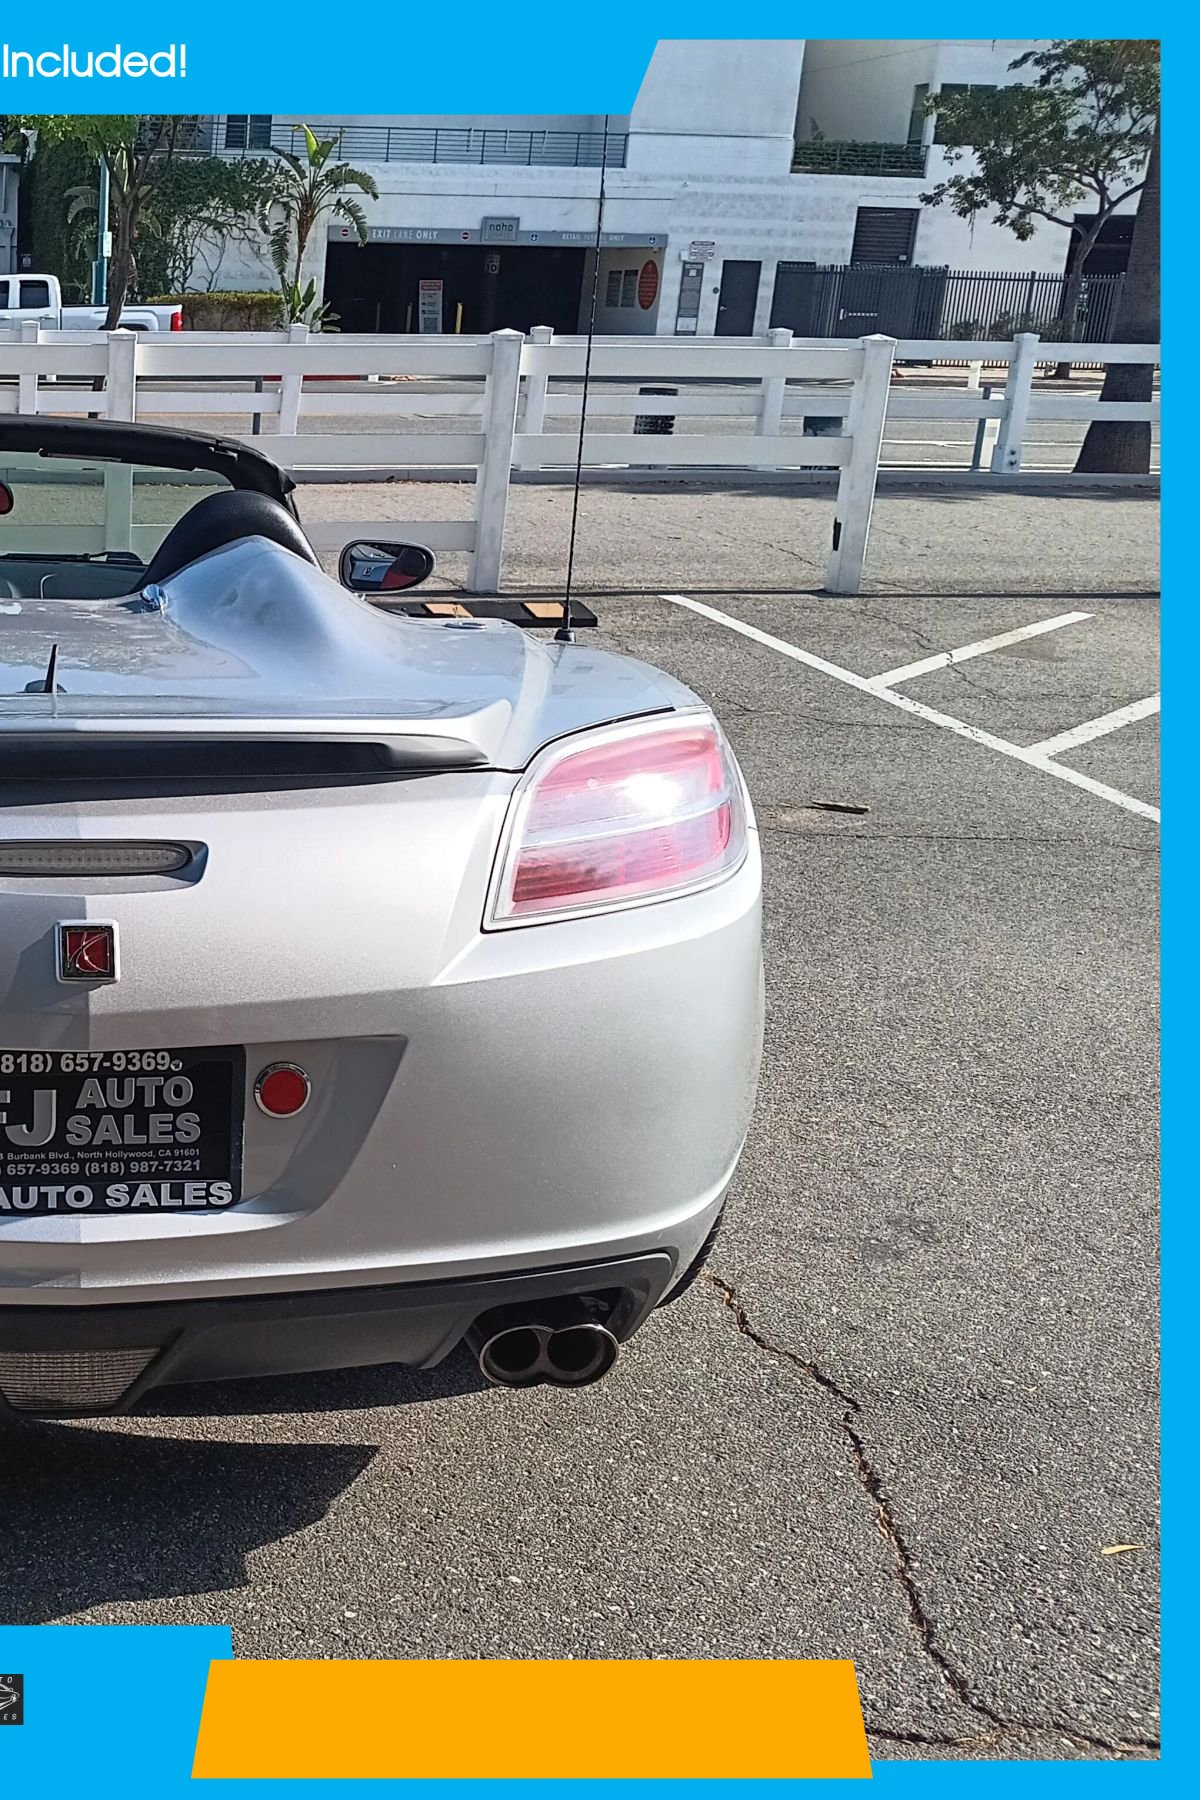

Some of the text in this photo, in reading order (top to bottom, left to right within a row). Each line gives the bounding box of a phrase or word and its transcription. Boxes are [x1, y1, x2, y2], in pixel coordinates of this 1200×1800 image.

[372, 229, 391, 239] EXIT
[416, 230, 438, 240] ONLY
[489, 222, 514, 232] noho
[60, 1051, 171, 1073] 657-9369
[75, 1076, 194, 1109] AUTO
[65, 1112, 201, 1146] SALES
[6, 1151, 46, 1160] Burbank
[76, 1151, 103, 1160] North
[105, 1149, 156, 1162] Hollywood,
[158, 1149, 172, 1158] CA
[173, 1148, 200, 1157] 91601
[6, 1162, 80, 1176] 657-9369
[84, 1161, 125, 1177] (818)
[129, 1159, 201, 1174] 987-7321
[105, 1181, 233, 1208] SALES
